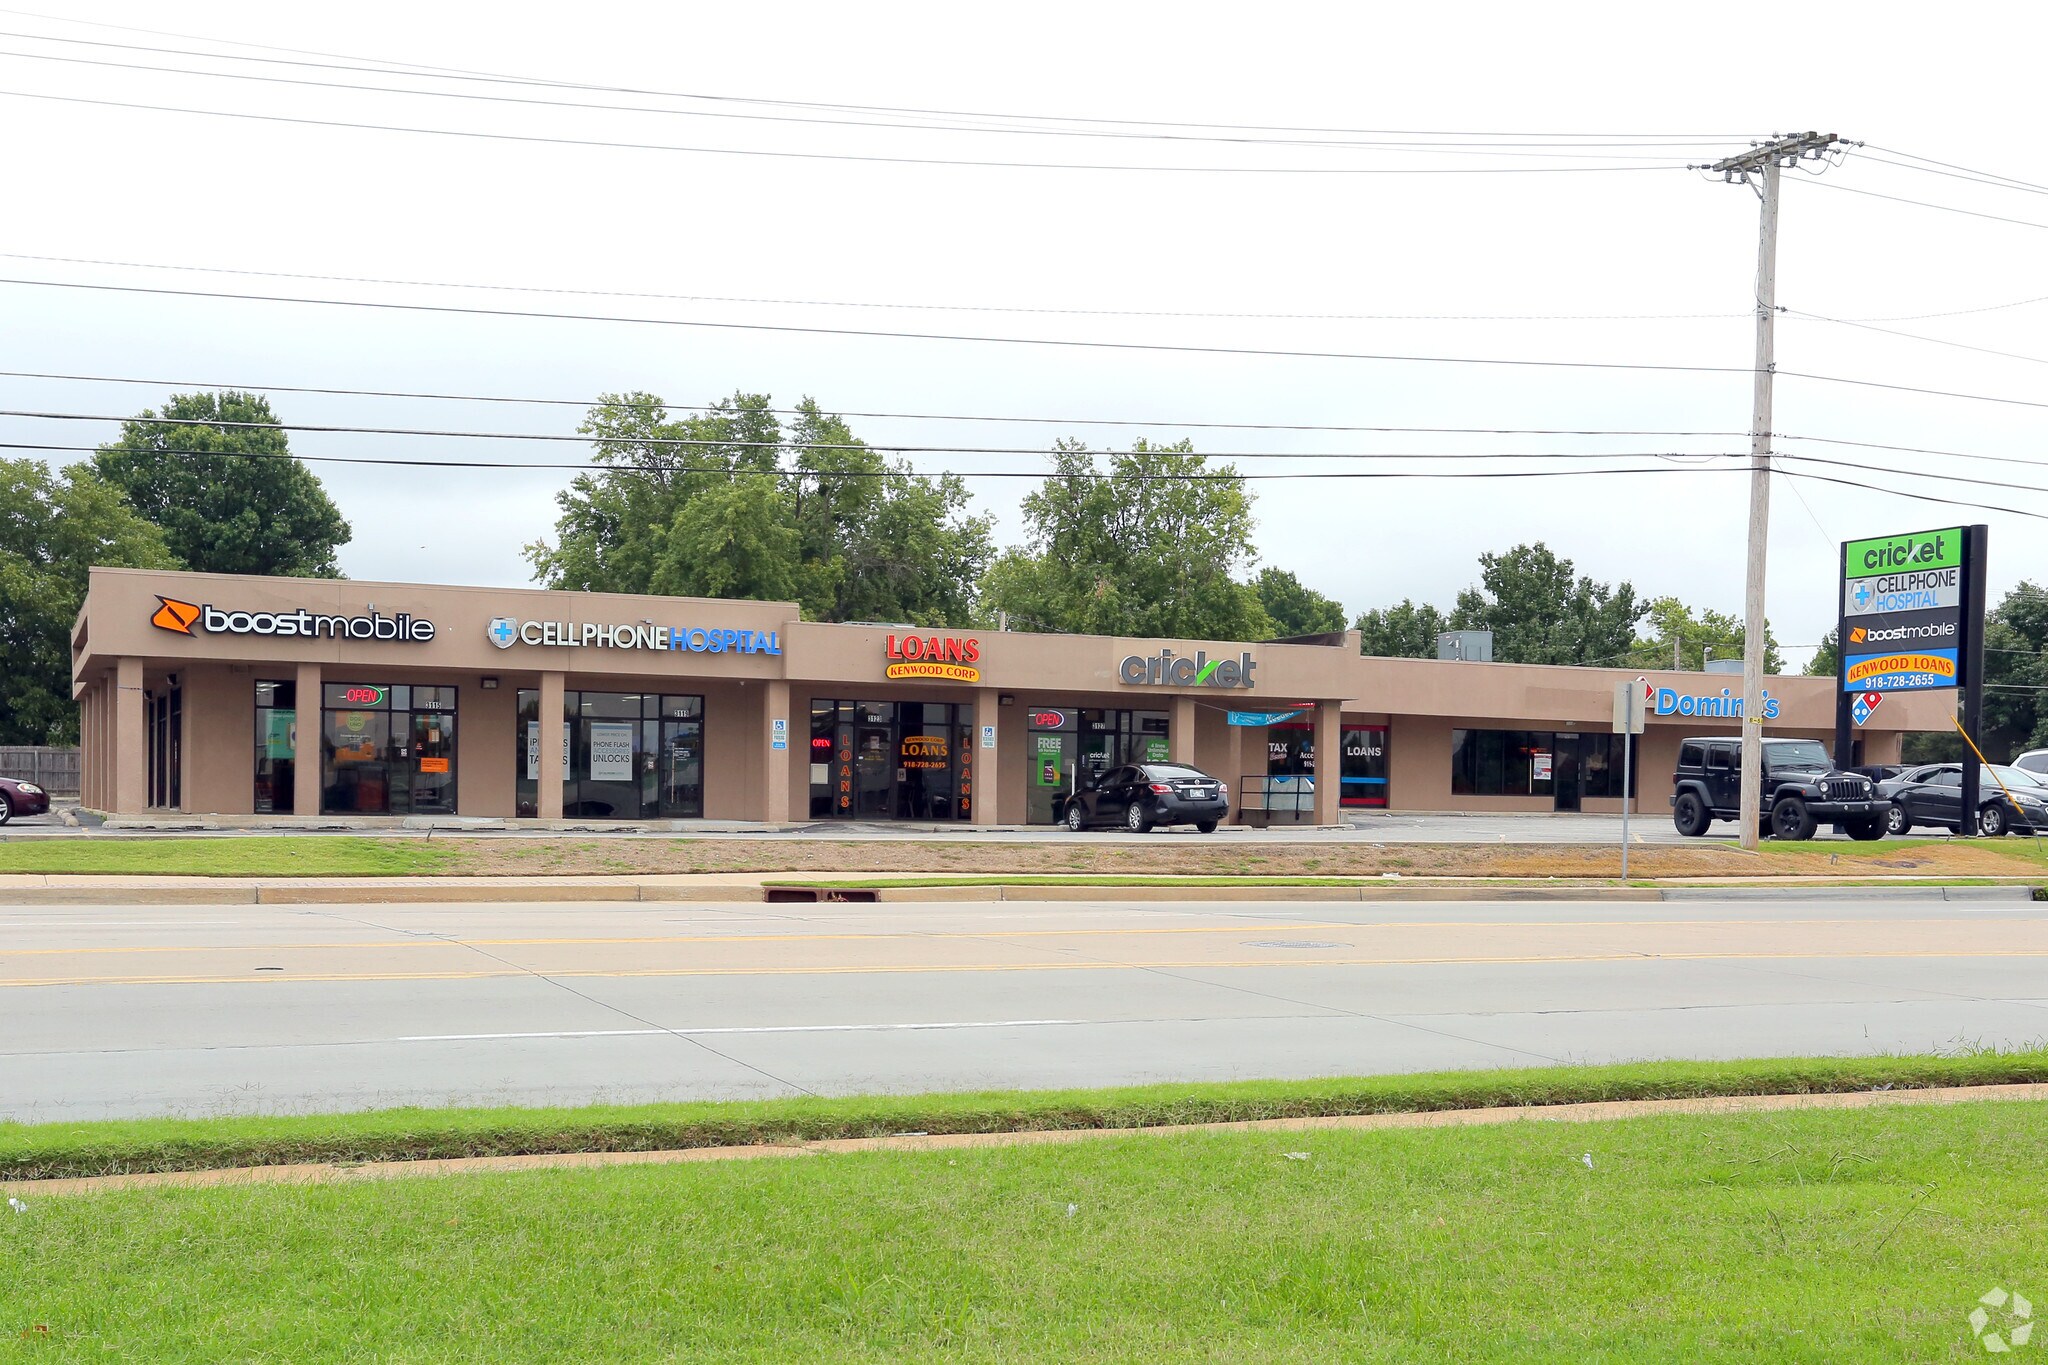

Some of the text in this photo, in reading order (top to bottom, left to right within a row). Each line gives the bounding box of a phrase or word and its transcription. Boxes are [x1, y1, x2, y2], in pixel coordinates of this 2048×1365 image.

[1864, 535, 1945, 569] cricket
[1876, 590, 1938, 611] HOSPITAL
[204, 605, 436, 642] boostmobile
[1867, 622, 1955, 642] boostmobile
[669, 627, 782, 655] HOSPITAL
[886, 634, 981, 663] LOANS
[889, 665, 976, 679] KENWOOD CORP
[1119, 648, 1257, 689] cricket
[1850, 657, 1952, 680] KENWOOD LOANS
[1865, 673, 1934, 689] 918-728-2655
[346, 689, 378, 702] OPEN
[1654, 687, 1780, 719] Domin's
[1035, 713, 1060, 726] OPEN
[812, 738, 831, 747] OPEN
[901, 744, 948, 756] LOANS
[1037, 737, 1062, 749] FREE
[1268, 743, 1288, 753] TAX
[1347, 746, 1382, 757] LOANS
[592, 754, 630, 763] UNLOCKS
[1089, 751, 1110, 759] cricket
[840, 734, 851, 808] LOANS
[961, 737, 972, 809] LOANS
